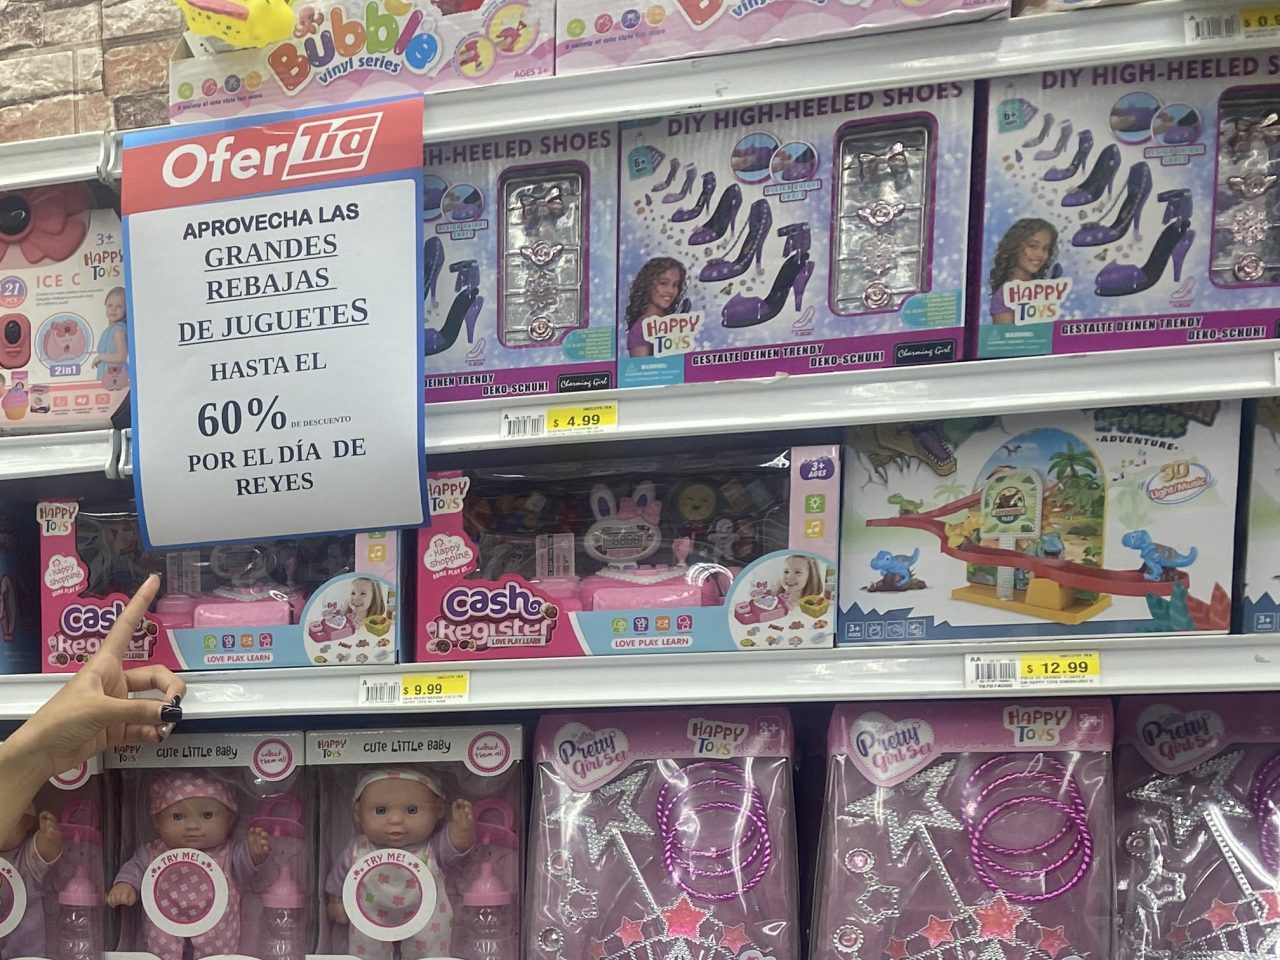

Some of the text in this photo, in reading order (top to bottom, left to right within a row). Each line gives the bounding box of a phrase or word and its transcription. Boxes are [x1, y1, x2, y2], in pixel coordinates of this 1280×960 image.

[268, 2, 438, 92] Bubble
[319, 53, 401, 84] vinyl series
[668, 82, 963, 136] DIY HIGH-HEELED SHOES
[183, 203, 359, 240] APROVECHA LAS
[204, 233, 337, 268] GRANDES
[206, 267, 329, 301] REBAJAS
[1008, 282, 1067, 302] HAPPY
[178, 297, 368, 343] DE JUGUETES
[1017, 302, 1057, 320] TOYS
[691, 344, 824, 366] GESTALTE DEINEN TRENDY
[810, 352, 885, 367] DEKO-SCHUH!
[897, 345, 952, 358] Charming Girl
[210, 352, 327, 382] HASTA EL
[197, 395, 352, 437] 60% DE DESCUENTO
[566, 414, 600, 426] 4.99
[188, 438, 366, 473] POR EL DÍA DE
[1161, 460, 1190, 482] 3D
[236, 472, 314, 496] REYES
[1150, 476, 1209, 500] Light/Music
[445, 583, 542, 619] cash
[439, 618, 553, 643] Register
[615, 639, 636, 648] LOVE
[662, 637, 689, 647] LEARN
[1041, 661, 1089, 674] 12.99
[365, 853, 406, 866] TRY ME!
